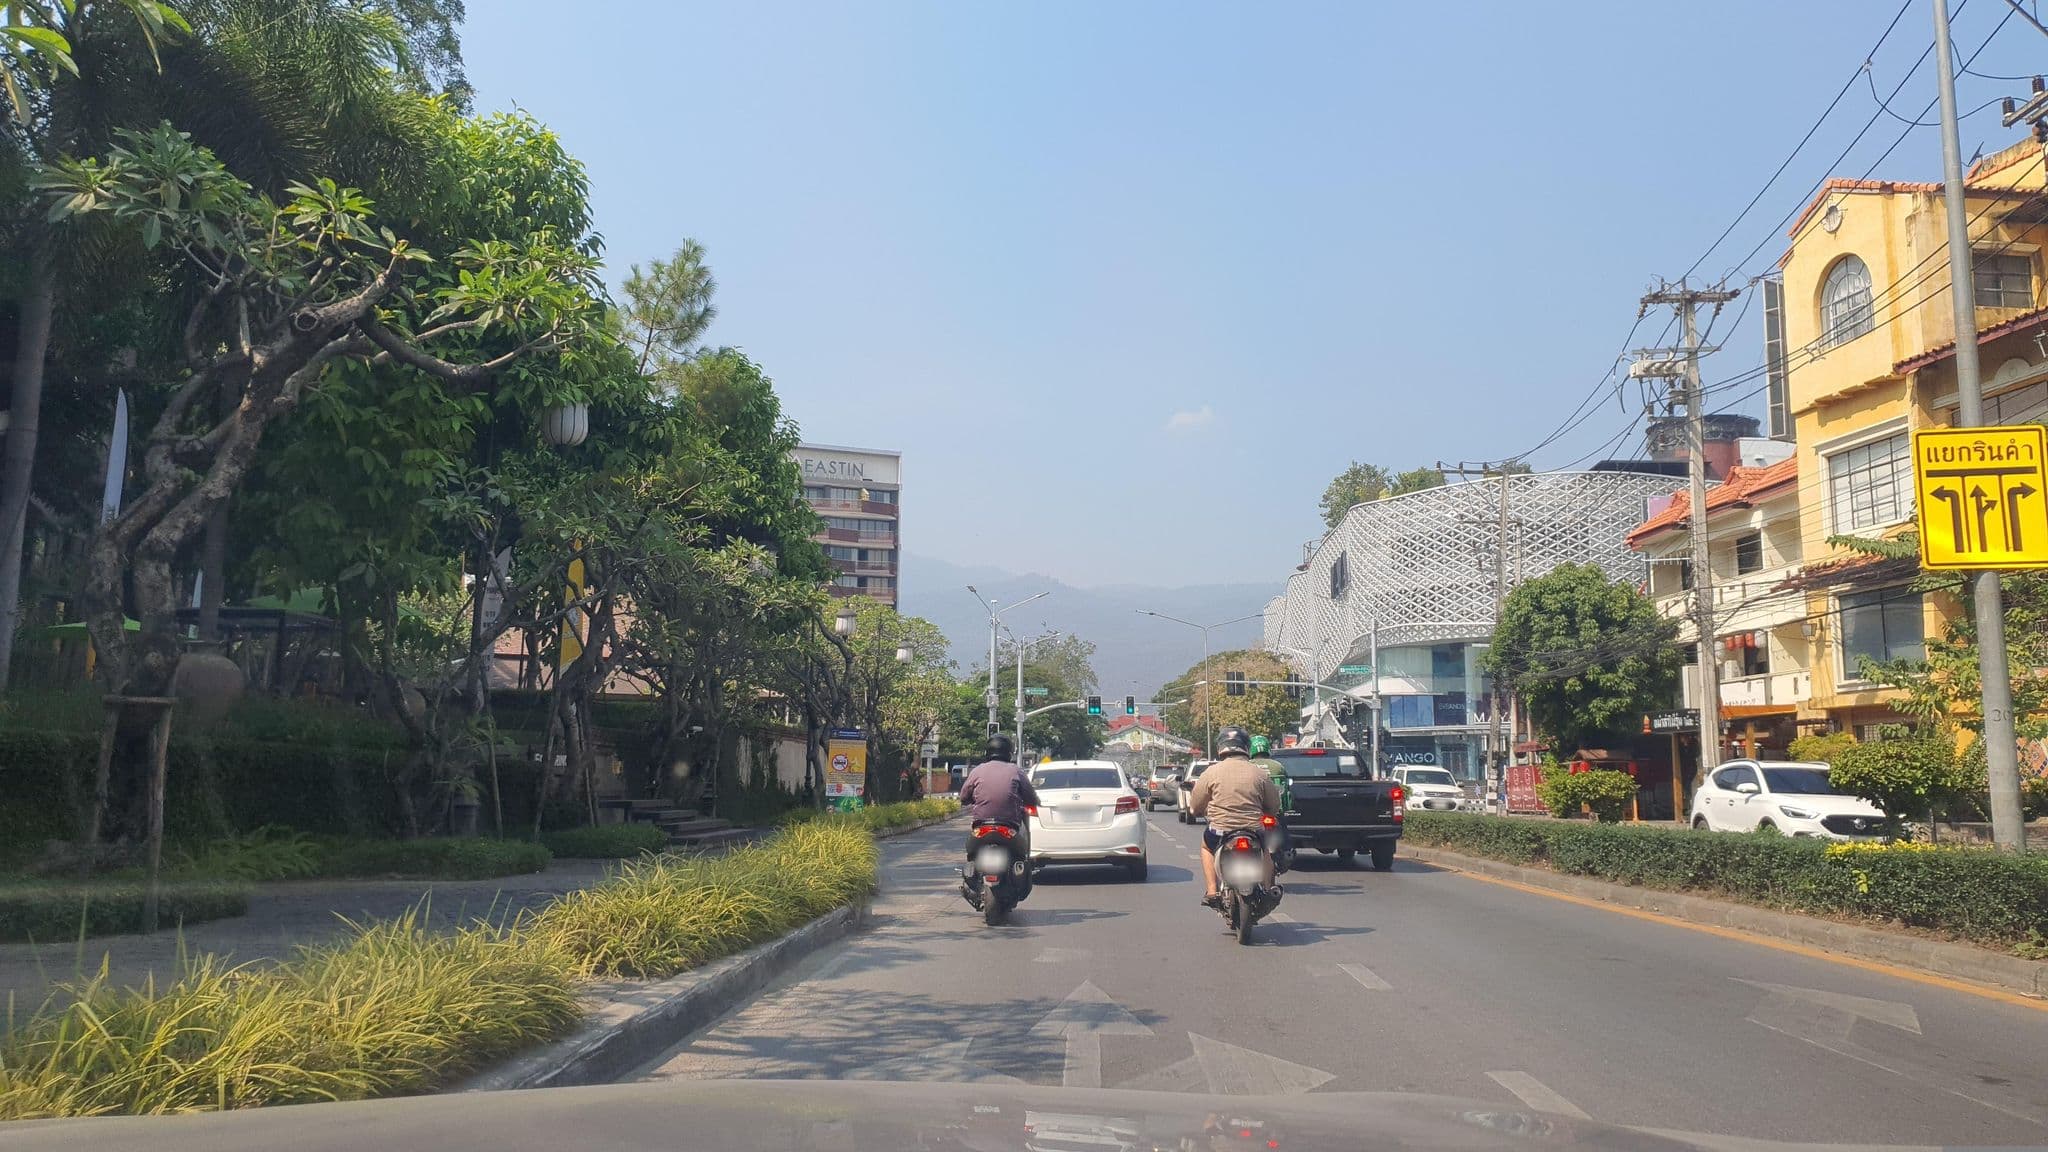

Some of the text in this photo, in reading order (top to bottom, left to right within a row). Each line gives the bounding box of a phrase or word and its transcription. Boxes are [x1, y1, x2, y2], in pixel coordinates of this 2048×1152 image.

[1927, 438, 2034, 463] แยกรินคำ
[804, 459, 864, 476] EASTIN
[1389, 752, 1435, 764] ANGO
